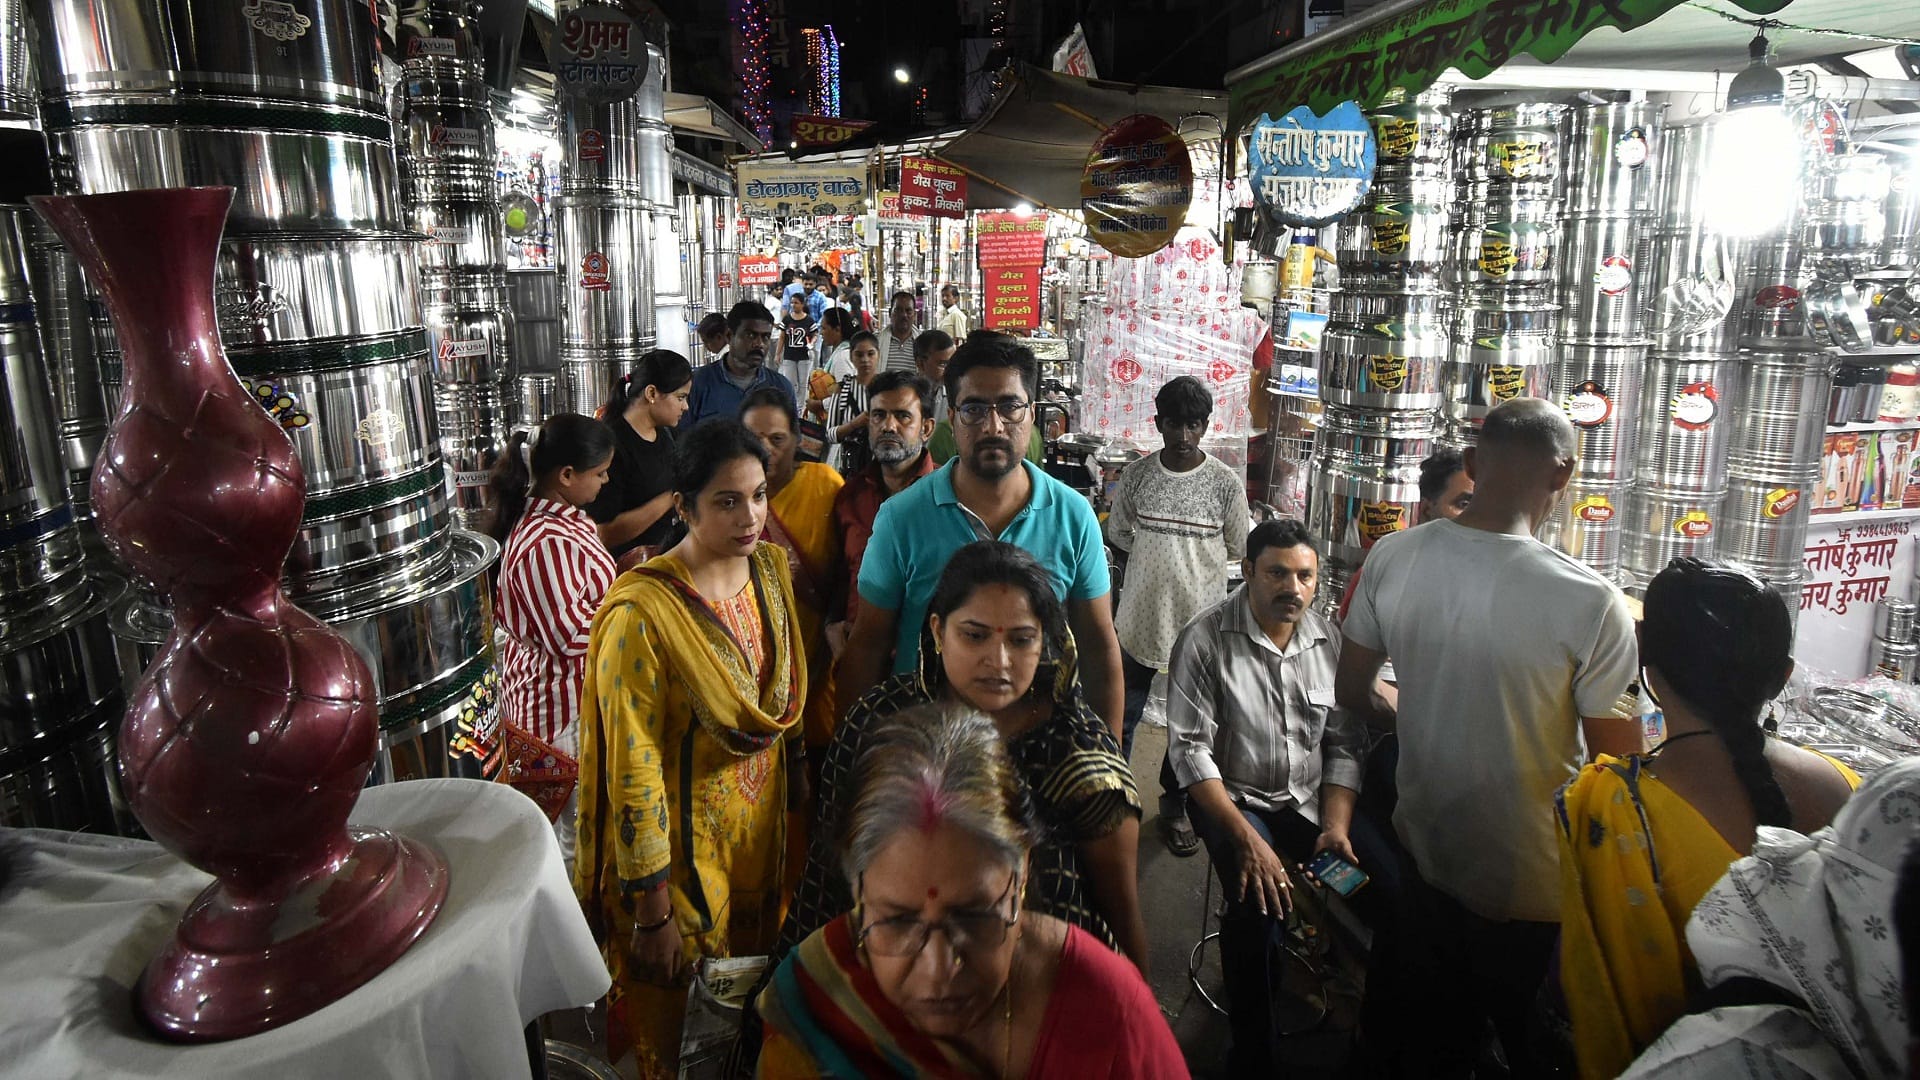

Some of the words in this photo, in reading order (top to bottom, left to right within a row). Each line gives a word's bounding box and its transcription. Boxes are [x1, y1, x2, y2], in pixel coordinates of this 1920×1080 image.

[822, 176, 862, 197] वाले
[912, 172, 931, 188] गैस
[786, 327, 806, 348] 12
[1803, 539, 1846, 572] तोष
[1841, 538, 1898, 577] कुमार
[1800, 582, 1833, 610] जय
[1830, 576, 1891, 615] कुमार
